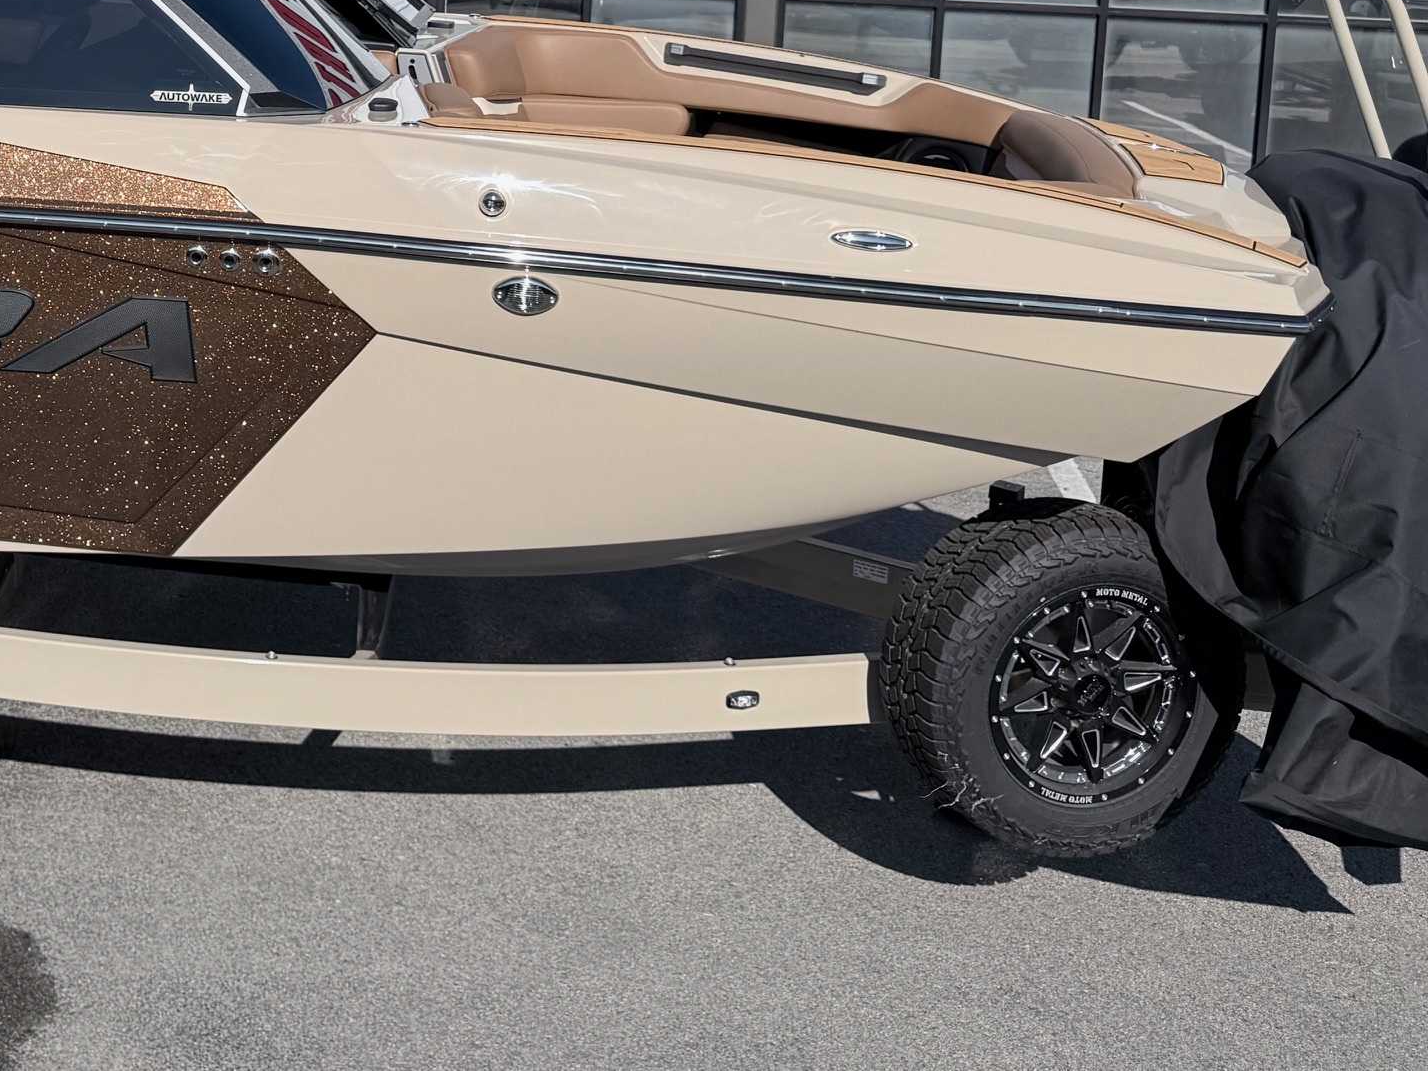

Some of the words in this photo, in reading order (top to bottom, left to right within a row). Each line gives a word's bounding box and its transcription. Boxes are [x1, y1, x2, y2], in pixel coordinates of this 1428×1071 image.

[159, 92, 223, 103] AUTOWAKE
[1095, 588, 1120, 597] MOTO
[1121, 589, 1148, 606] METAL
[1041, 786, 1068, 802] METAL
[1068, 795, 1093, 804] MOTO
